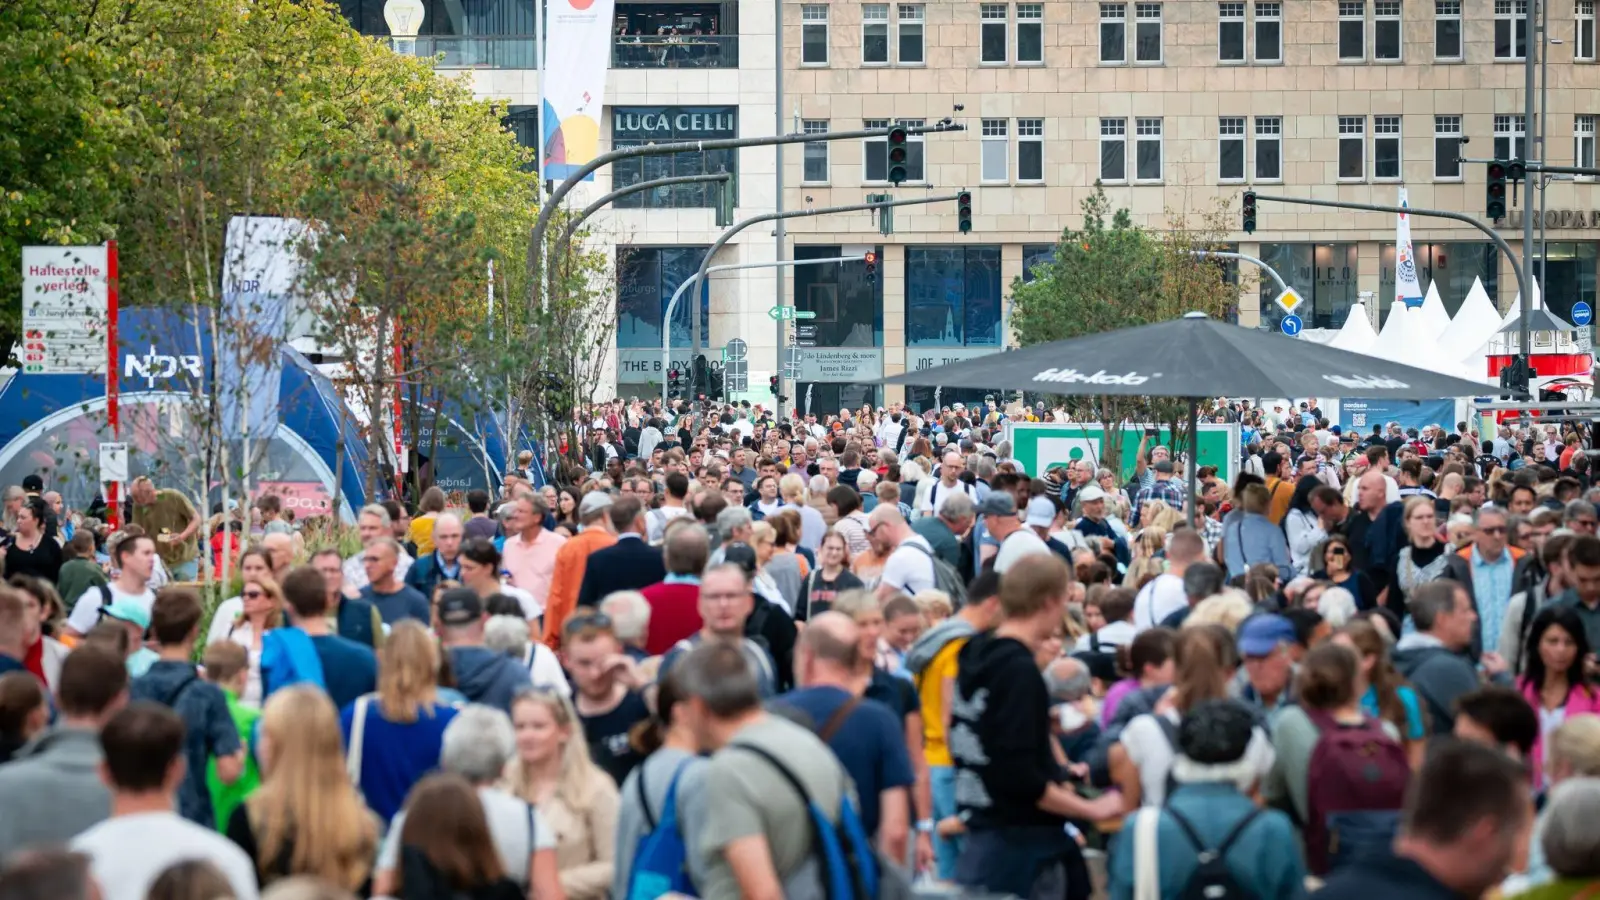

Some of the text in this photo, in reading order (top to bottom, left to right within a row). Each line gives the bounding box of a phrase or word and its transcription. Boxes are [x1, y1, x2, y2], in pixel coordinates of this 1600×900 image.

[616, 114, 733, 131] LUCA CELLI
[29, 265, 100, 276] Haltestelle
[232, 280, 260, 293] NDR
[816, 352, 851, 360] Lindenberg
[125, 349, 201, 382] NDR
[623, 361, 648, 371] THE
[653, 361, 689, 371] BDY
